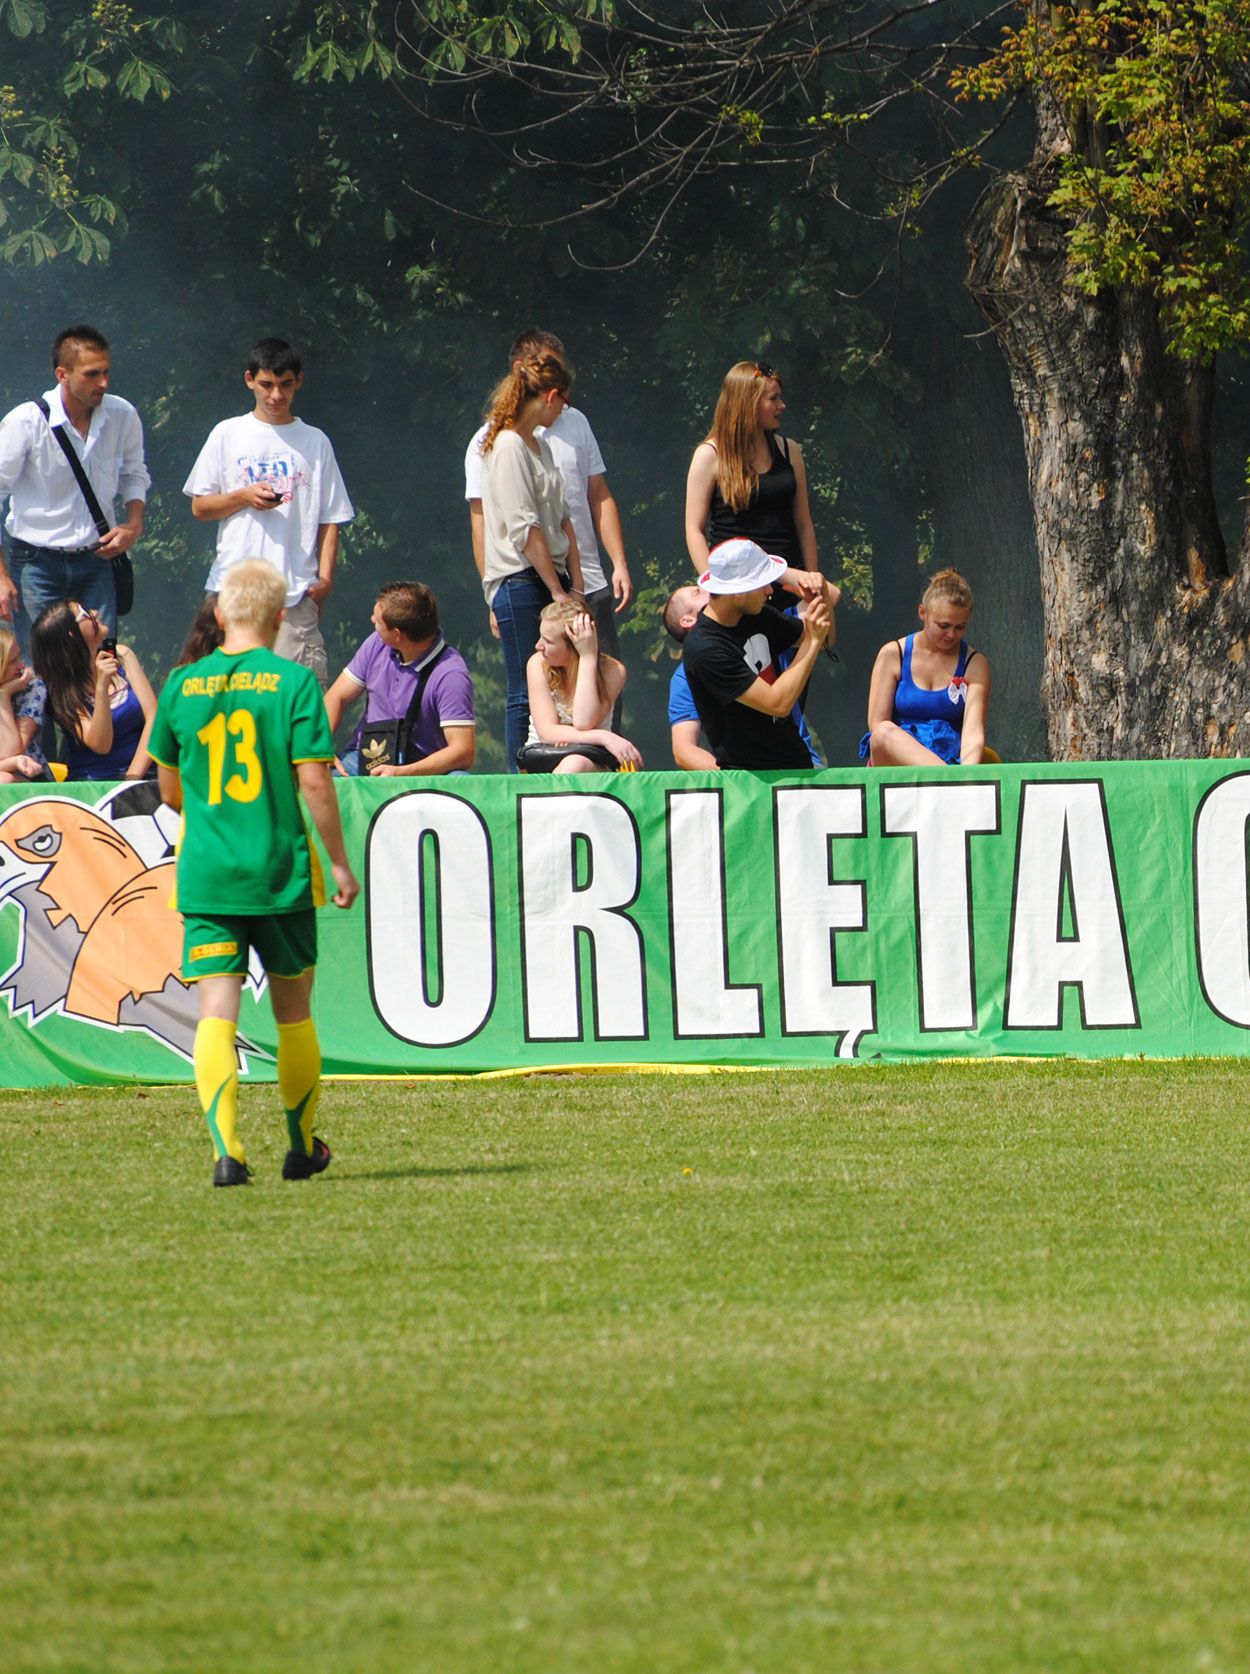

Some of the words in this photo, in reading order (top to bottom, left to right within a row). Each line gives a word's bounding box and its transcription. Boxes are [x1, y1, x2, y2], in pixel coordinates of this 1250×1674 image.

[197, 708, 263, 806] 13
[366, 753, 390, 770] adidas
[365, 779, 1142, 1058] ORLĘTA
